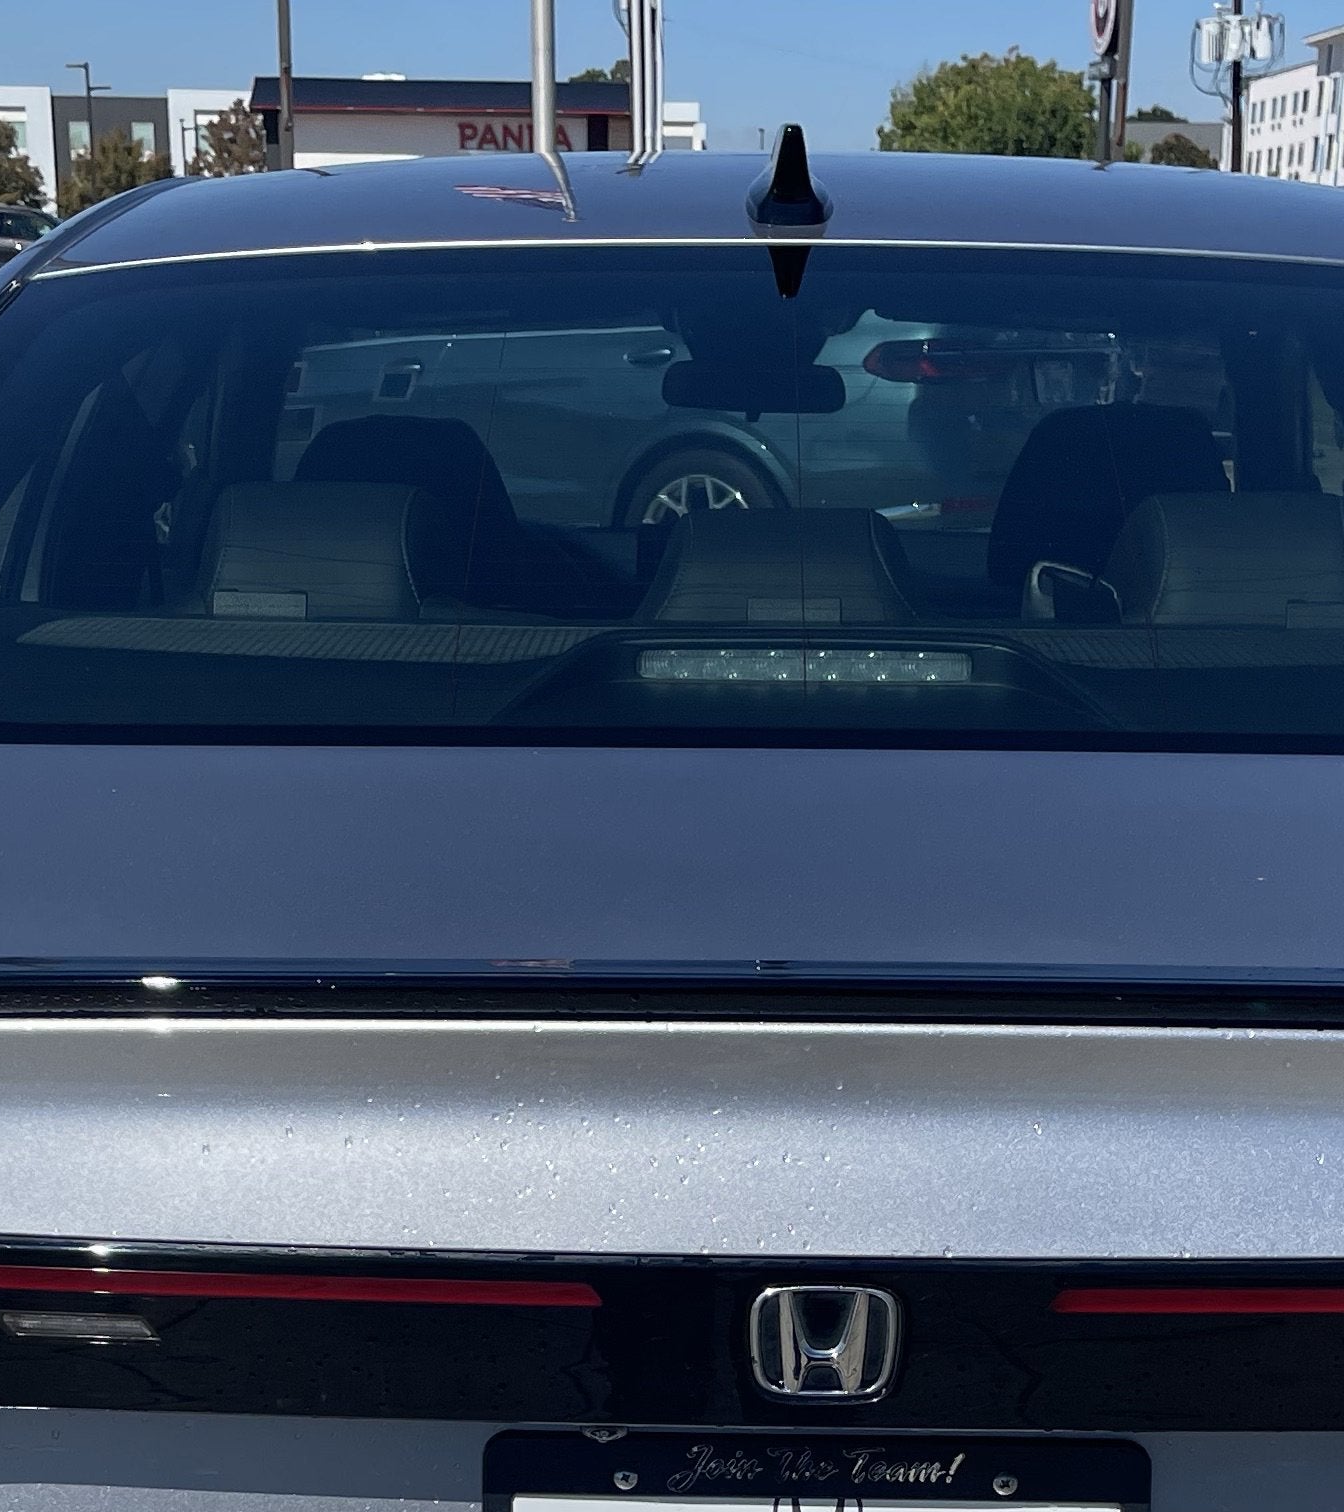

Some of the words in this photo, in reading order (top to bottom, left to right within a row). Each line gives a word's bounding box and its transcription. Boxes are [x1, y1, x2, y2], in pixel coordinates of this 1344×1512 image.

[667, 1445, 762, 1492] Join
[767, 1447, 839, 1482] The
[843, 1447, 966, 1484] Team!
